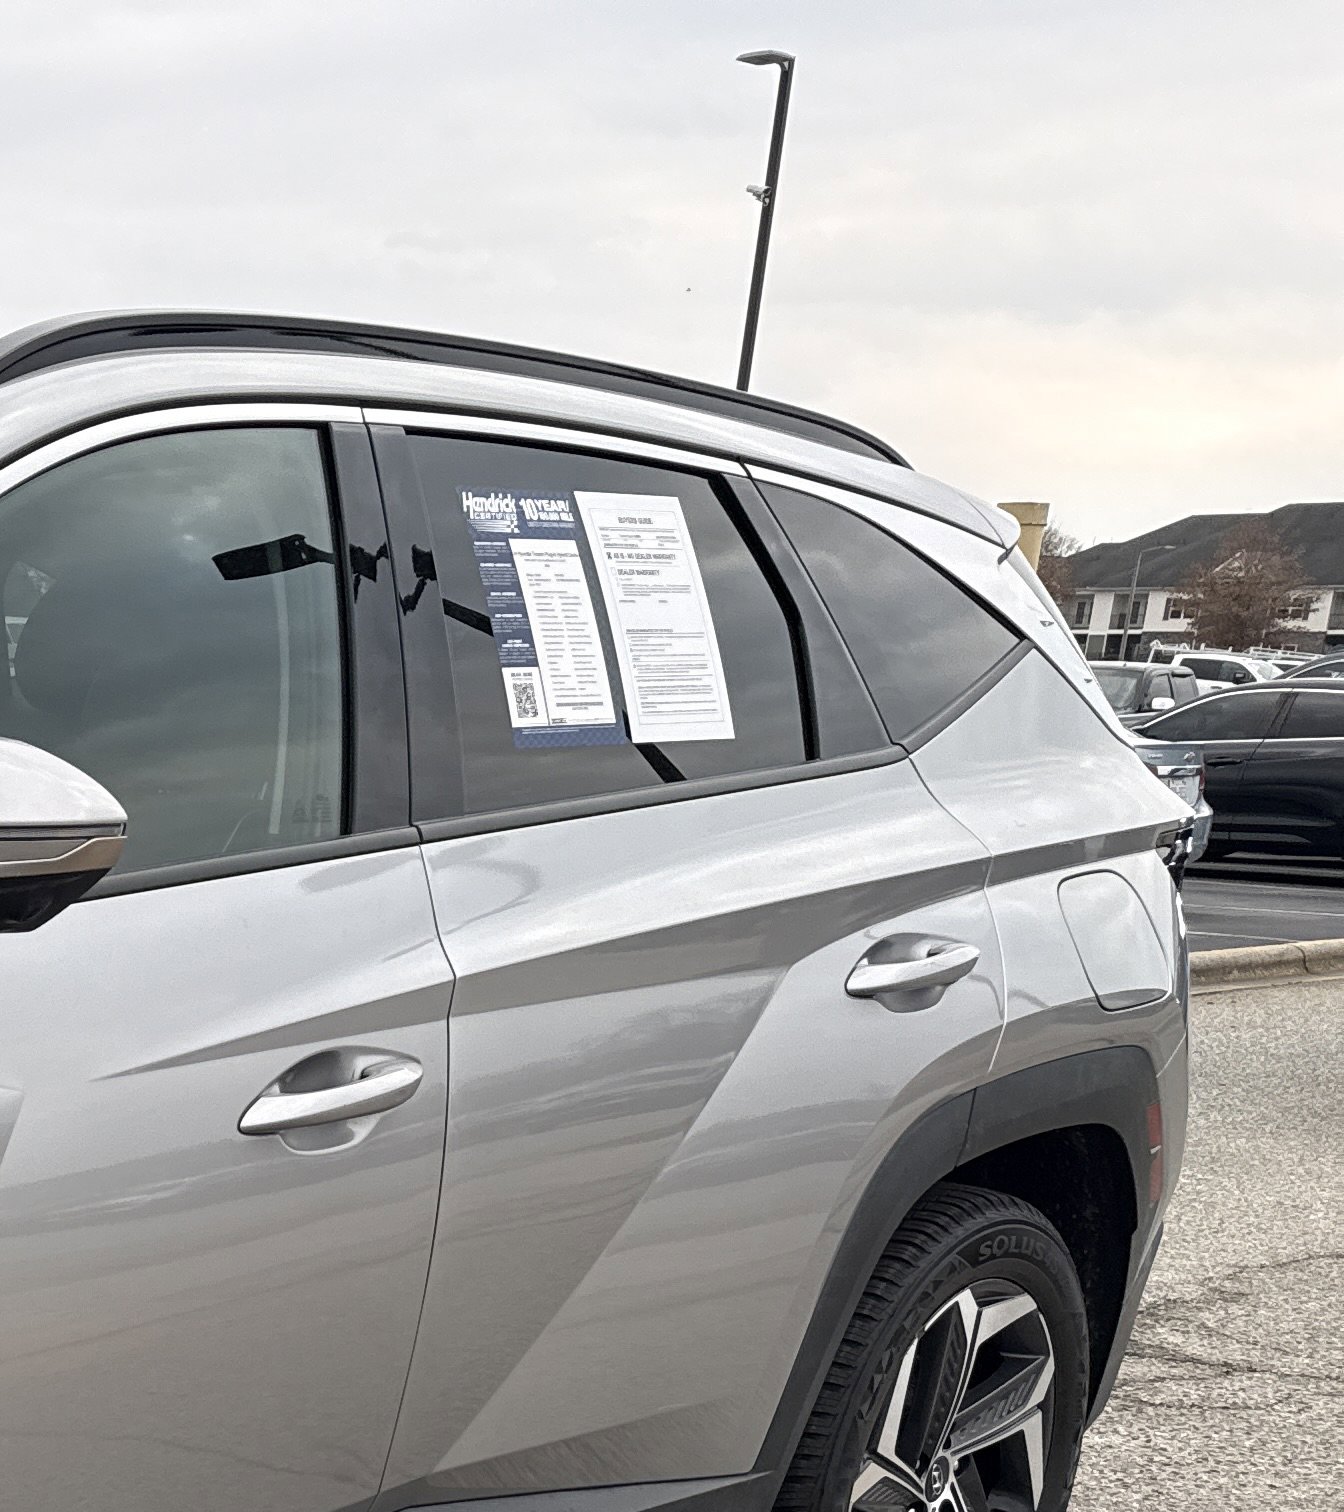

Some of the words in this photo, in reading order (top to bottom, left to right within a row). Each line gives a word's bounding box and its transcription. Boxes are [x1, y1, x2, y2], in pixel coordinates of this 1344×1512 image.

[462, 491, 516, 520] Hendrick
[519, 498, 539, 521] 10
[979, 1235, 1046, 1261] SOLUS
